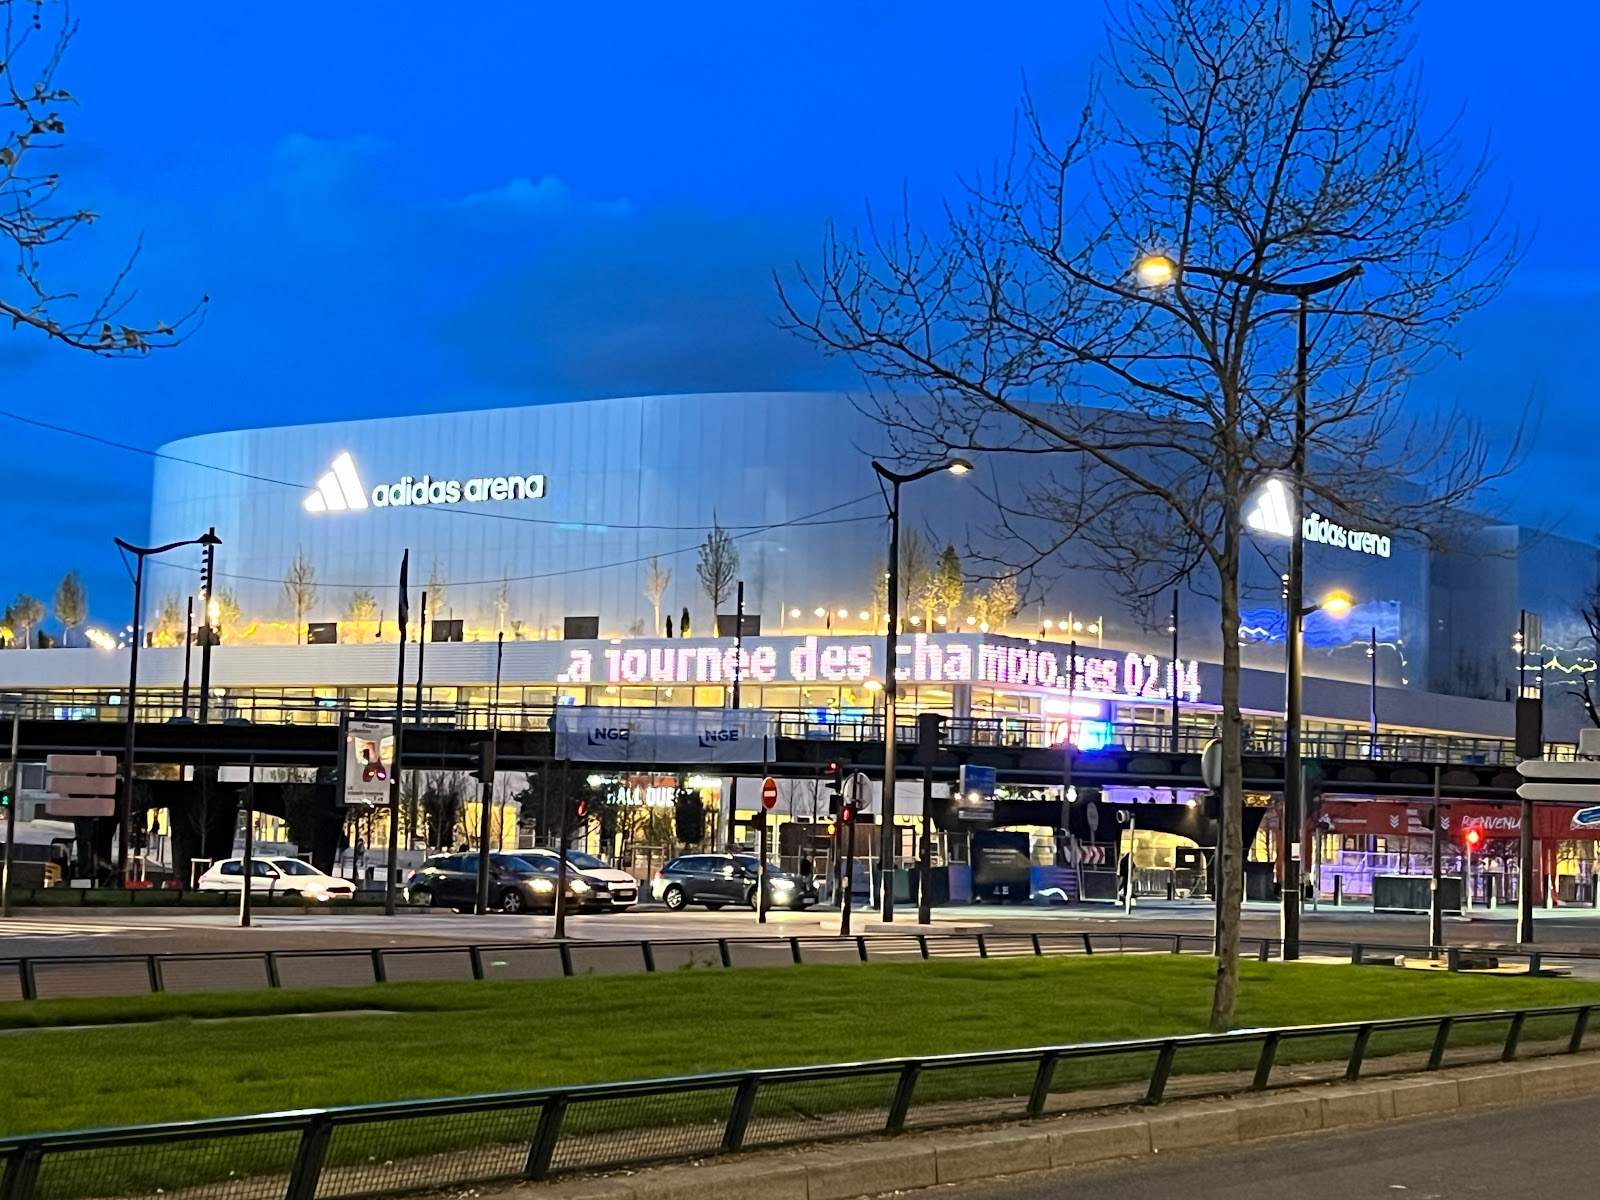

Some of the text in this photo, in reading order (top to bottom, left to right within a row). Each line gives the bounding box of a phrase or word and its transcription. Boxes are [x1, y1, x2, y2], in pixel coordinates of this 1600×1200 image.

[371, 474, 546, 507] adidas arena
[1347, 529, 1391, 558] arena
[557, 649, 592, 683] a
[604, 638, 777, 684] journée
[790, 635, 872, 682] des
[594, 727, 630, 740] NGE
[705, 729, 739, 742] NGE
